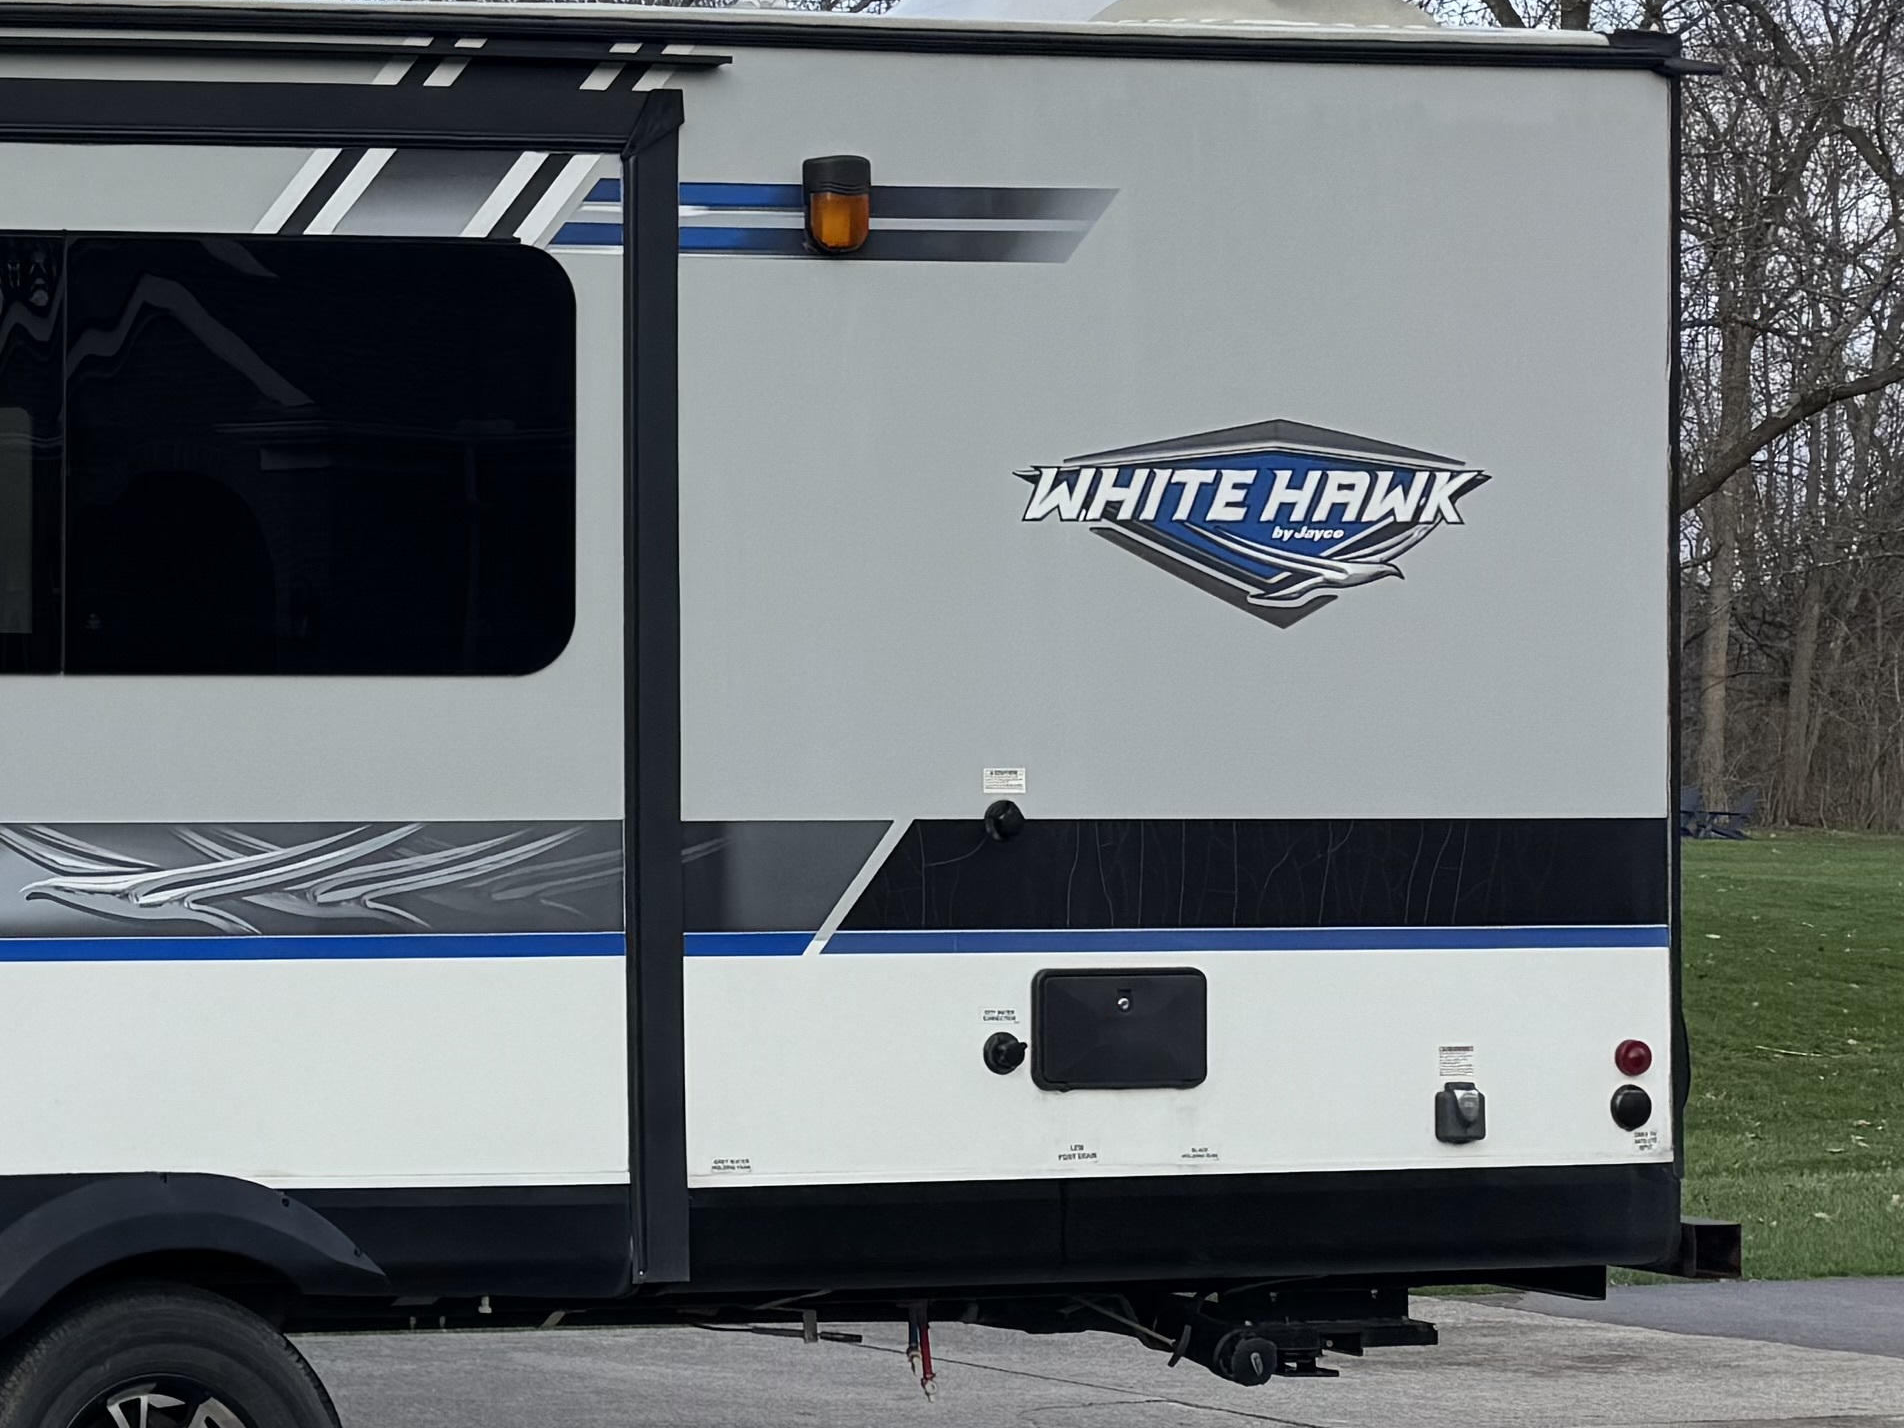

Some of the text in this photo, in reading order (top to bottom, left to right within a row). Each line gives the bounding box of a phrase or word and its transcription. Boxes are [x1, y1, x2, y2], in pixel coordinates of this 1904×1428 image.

[1020, 465, 1480, 525] WHITE HAWK
[1271, 525, 1345, 542] by Jayco
